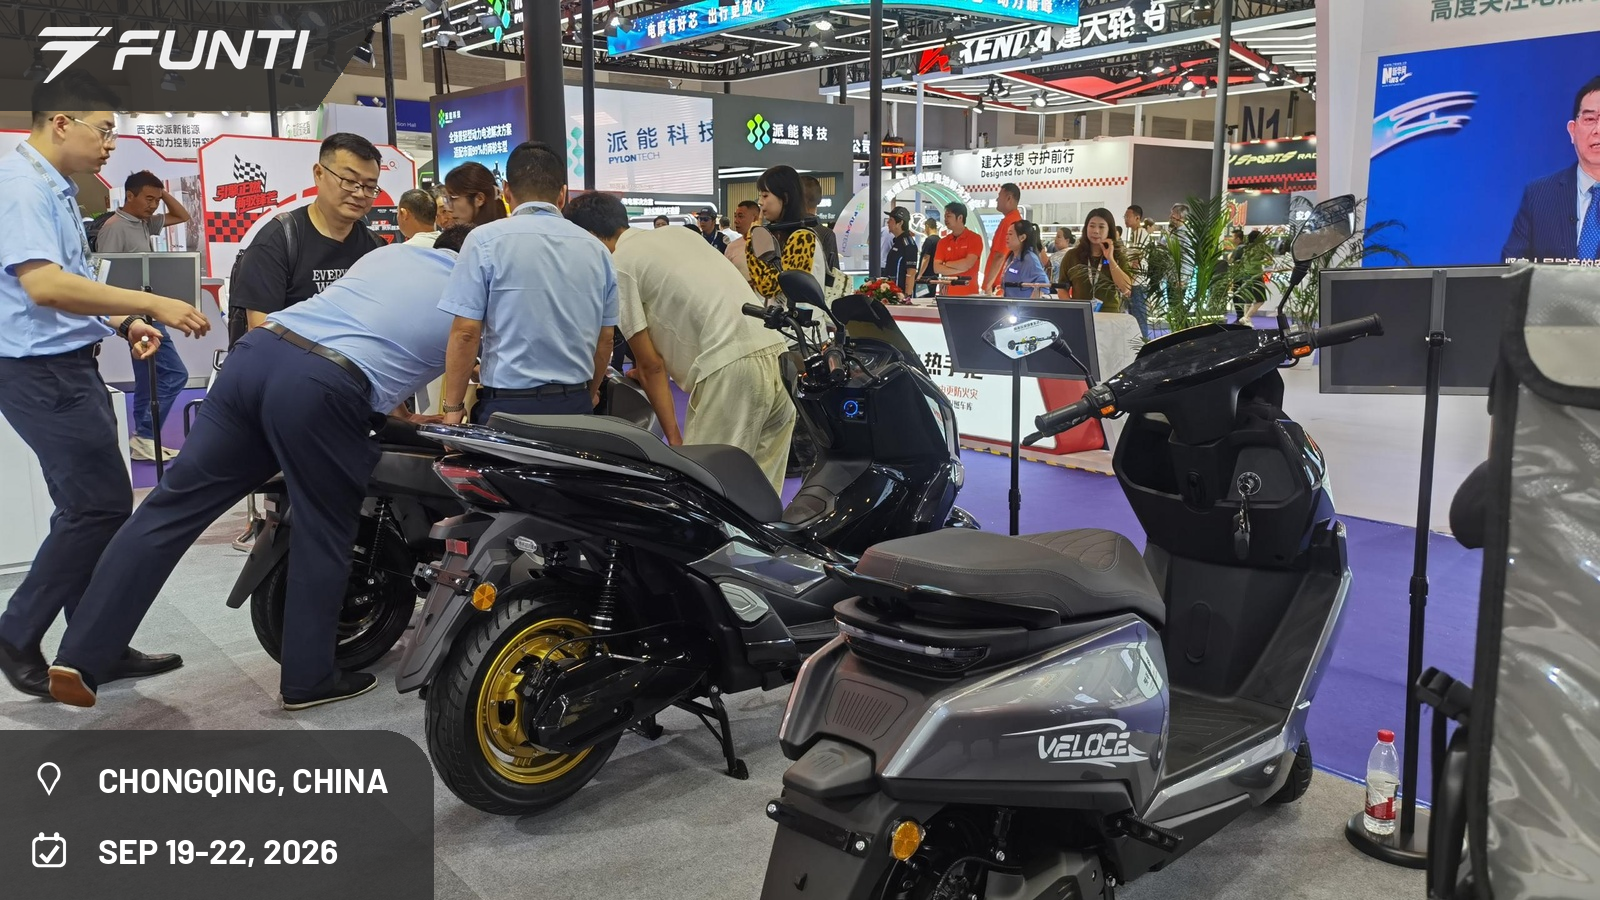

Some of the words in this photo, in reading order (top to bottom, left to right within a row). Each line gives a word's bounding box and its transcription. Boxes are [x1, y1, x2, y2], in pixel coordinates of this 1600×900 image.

[648, 12, 699, 39] 电摩有好芯
[707, 0, 765, 24] 出行更放心
[957, 26, 1052, 64] KENDA
[136, 124, 201, 135] 西安芯派新能源
[771, 122, 828, 141] 派能科技
[1242, 105, 1280, 140] N1
[607, 119, 714, 153] 派能科技
[608, 151, 661, 165] PYLONTECH
[981, 152, 1025, 169] 建大梦想
[1028, 148, 1075, 166] 守护前行
[1234, 150, 1298, 166] SPORTS
[981, 168, 1013, 179] Designed
[1014, 167, 1025, 176] for
[1026, 167, 1042, 175] Your
[1043, 165, 1074, 175] Journey
[1038, 732, 1131, 759] VELOCE
